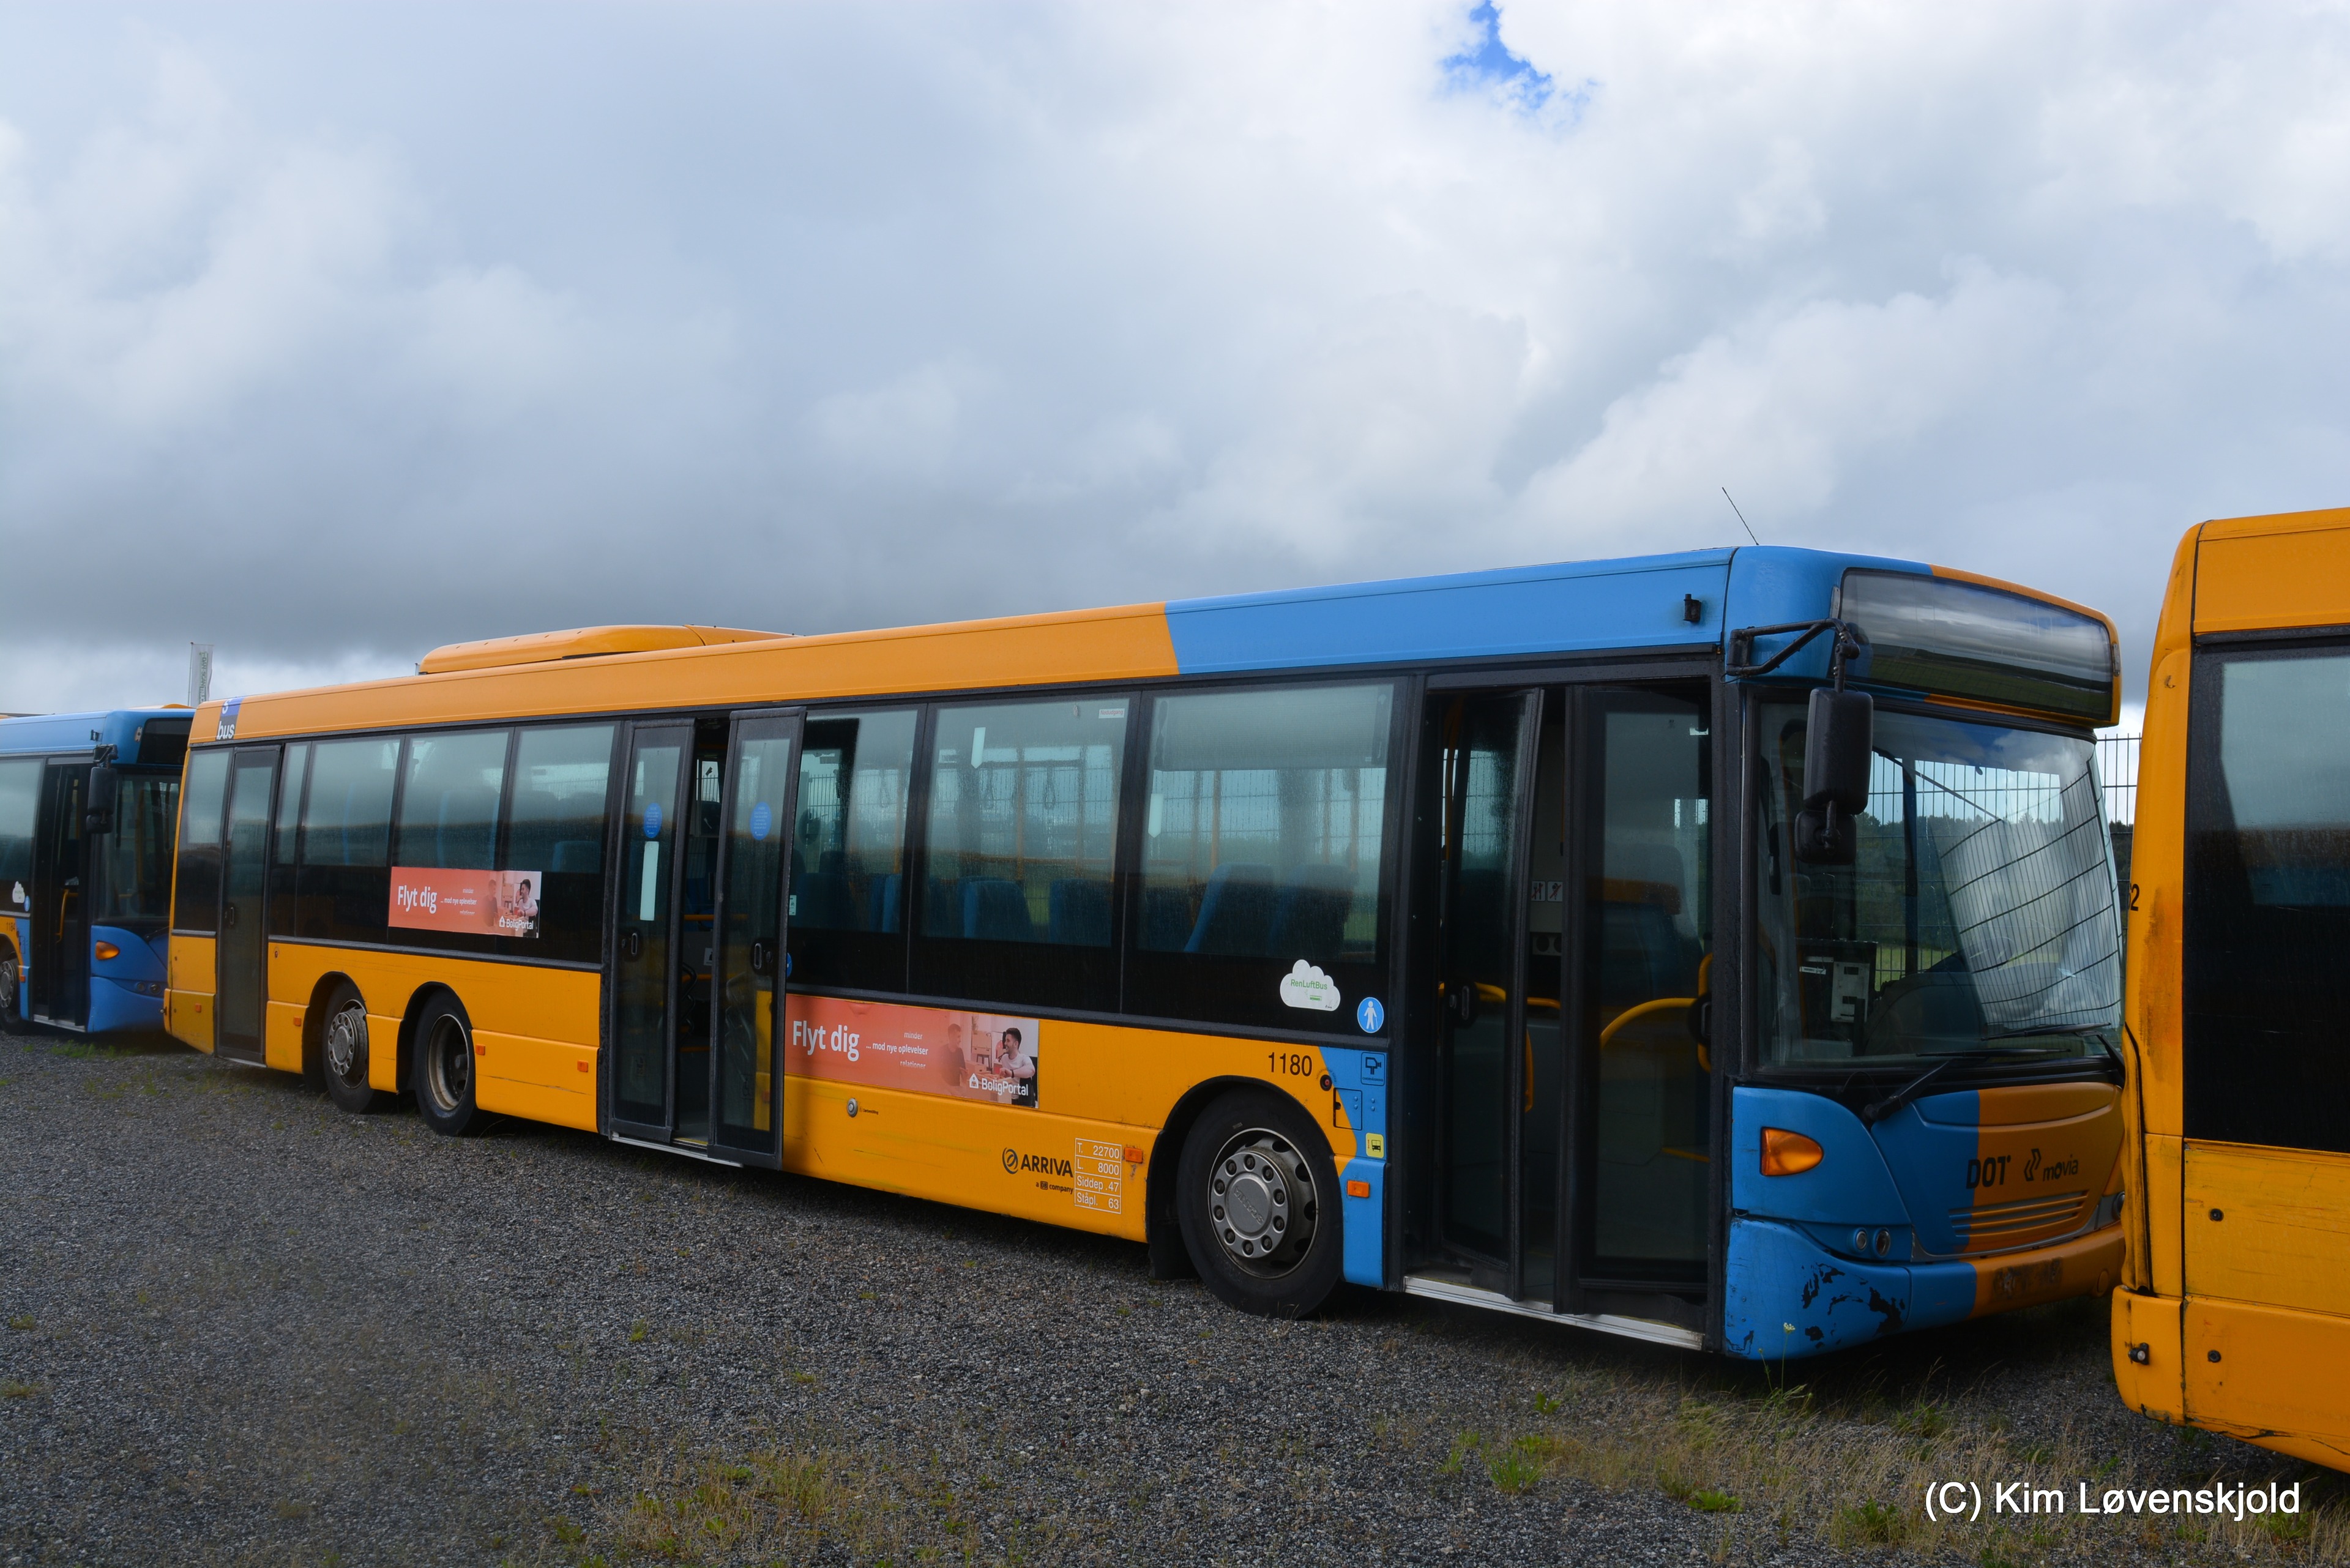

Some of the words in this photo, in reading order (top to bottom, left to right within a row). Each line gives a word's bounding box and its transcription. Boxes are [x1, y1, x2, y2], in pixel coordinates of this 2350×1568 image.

[216, 721, 234, 740] bus
[398, 885, 417, 912] Flyt
[420, 886, 437, 914] dig
[507, 919, 534, 931] BoligPortal
[1291, 979, 1327, 990] RenLuftBus
[793, 1020, 826, 1056] Flyt
[831, 1025, 859, 1062] dig
[904, 1031, 923, 1040] minder
[873, 1042, 885, 1051] mod
[898, 1044, 928, 1055] oplevelser
[900, 1061, 926, 1069] relationer
[1268, 1052, 1312, 1077] 1180
[982, 1078, 1028, 1096] BoligPortal
[1077, 1143, 1083, 1154] T.
[1093, 1145, 1119, 1159] 22700
[1021, 1154, 1073, 1178] ARRIVA
[1077, 1159, 1083, 1170] L.
[1098, 1163, 1119, 1175] 8000
[2043, 1154, 2078, 1182] movia
[1049, 1184, 1073, 1195] company
[1077, 1192, 1098, 1207] Ståpl.
[1108, 1198, 1119, 1209] 63
